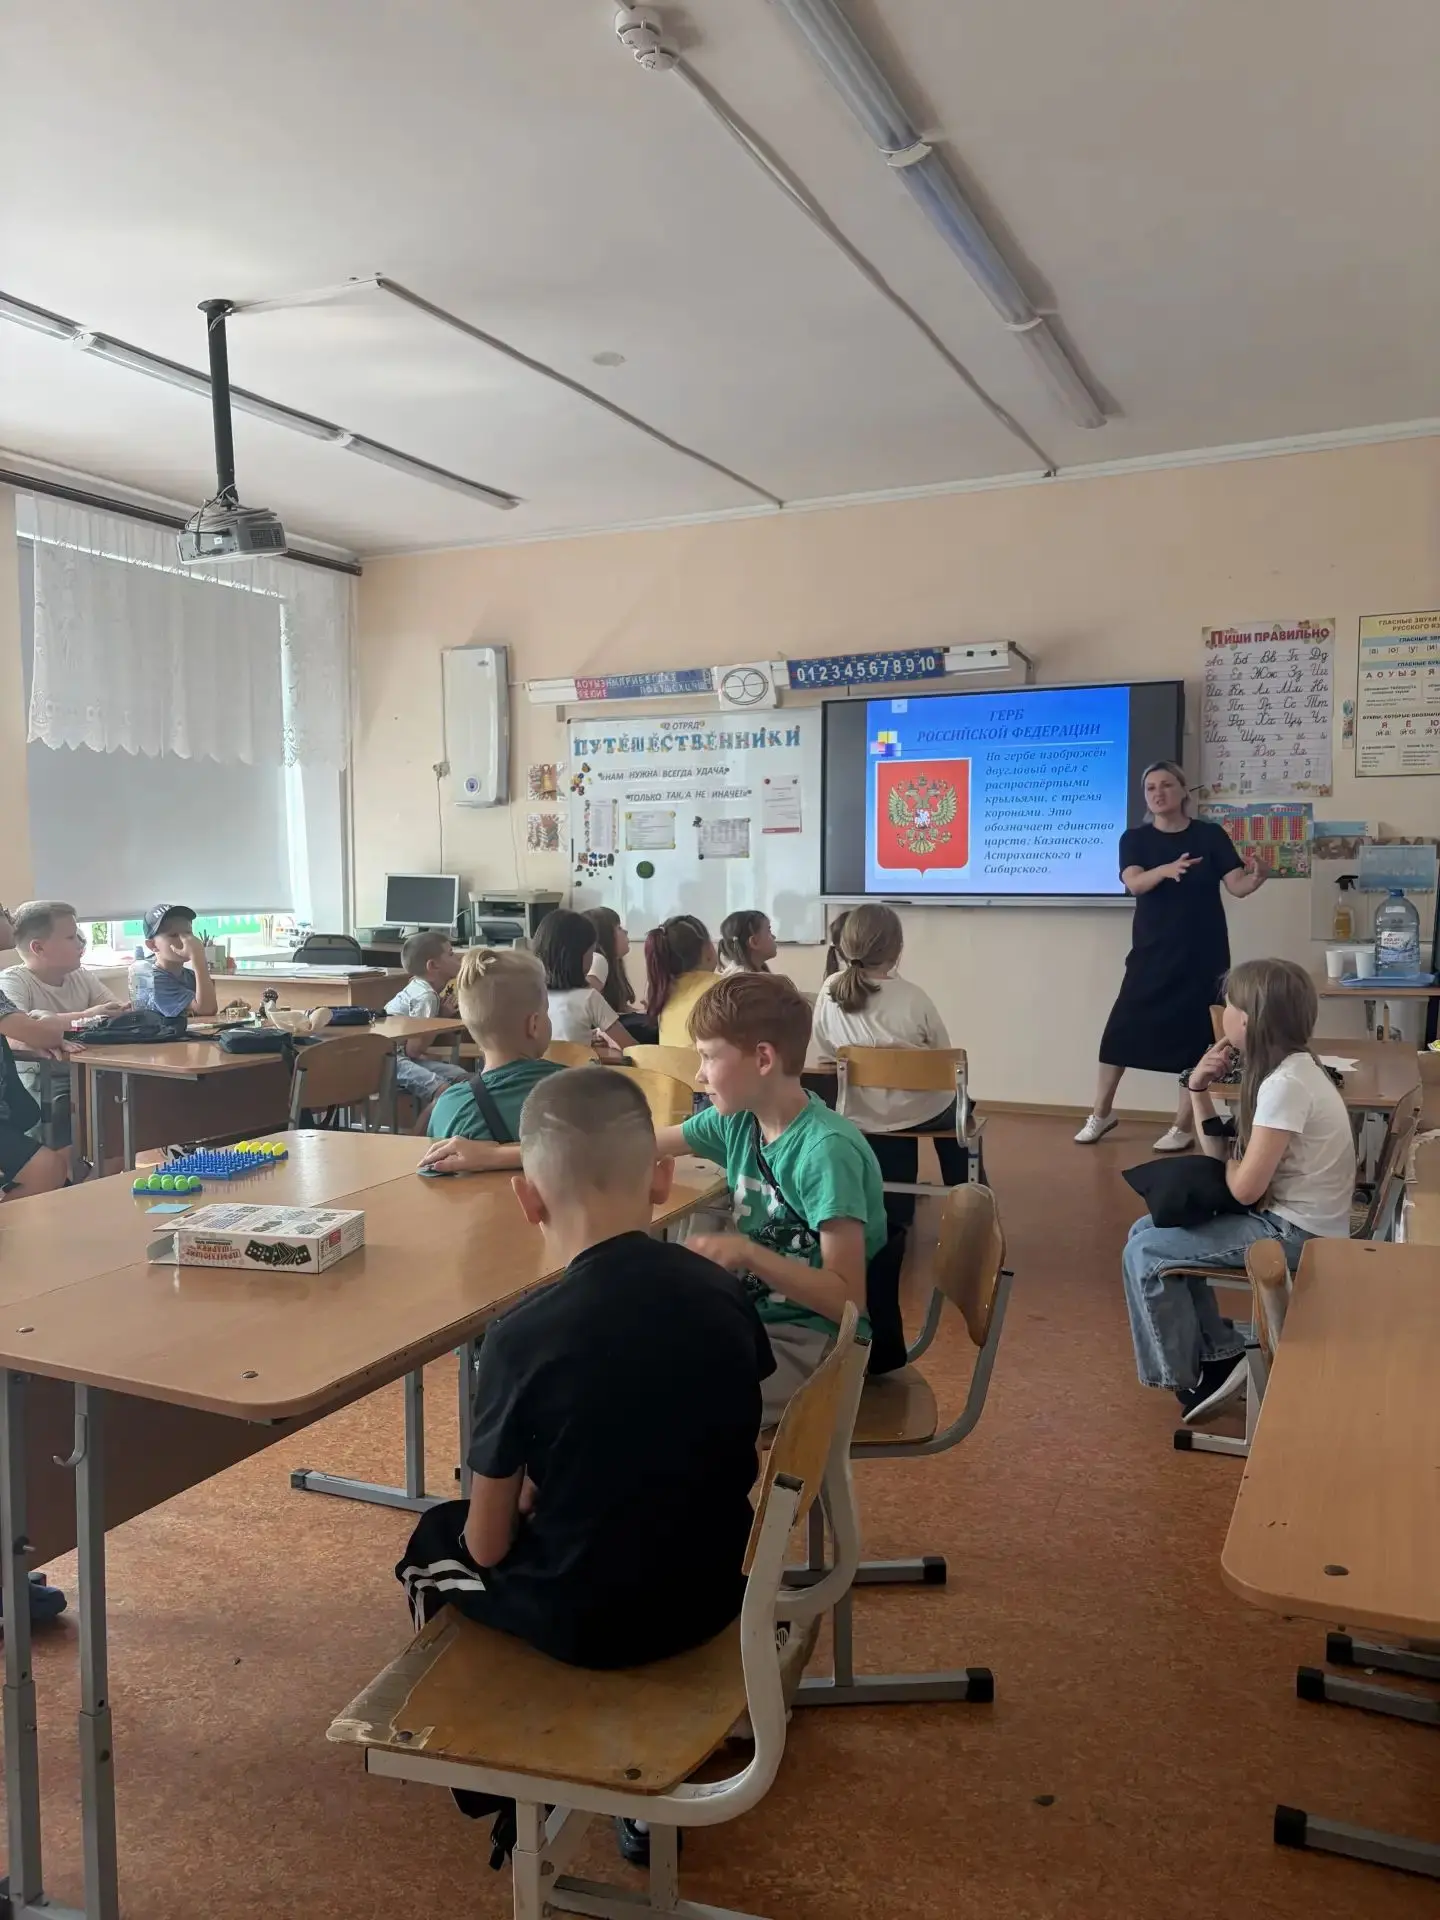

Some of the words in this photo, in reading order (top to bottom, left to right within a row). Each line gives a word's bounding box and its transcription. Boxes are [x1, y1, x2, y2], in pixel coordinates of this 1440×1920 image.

[1392, 624, 1430, 632] РУССКОГО
[1210, 631, 1252, 647] ПИШИ
[1254, 628, 1330, 643] ПРАВИЛЬНО
[1233, 652, 1252, 665] Бб
[1260, 650, 1277, 664] Вв
[1309, 647, 1329, 663] Дд
[797, 668, 806, 682] 0
[808, 667, 815, 681] 1
[819, 666, 829, 680] 2
[832, 665, 840, 679] 3
[845, 663, 853, 677] 4
[857, 662, 866, 676] 5
[869, 661, 878, 675] 6
[880, 660, 888, 674] 7
[893, 659, 902, 673] 8
[906, 658, 914, 672] 9
[919, 656, 935, 671] 10
[1250, 666, 1278, 680] Жж
[1288, 665, 1303, 682] Зз
[1376, 671, 1384, 679] О
[1411, 669, 1417, 677] Э
[1428, 668, 1435, 676] Я
[1276, 680, 1303, 694] Мм
[1310, 679, 1329, 692] Нн
[1284, 696, 1296, 709] Сс
[1304, 694, 1329, 707] Тт
[990, 708, 1025, 722] ГЕРБ
[673, 720, 700, 731] ОТРЯД
[1382, 721, 1388, 729] Я
[917, 725, 1008, 743] РОССИЙСКОЙ
[1012, 723, 1101, 740] ФЕДЕРАЦИИ
[574, 728, 800, 757] ПУТЕШЕСТВЕННИКИ
[986, 752, 1001, 761] На
[1004, 751, 1036, 762] гербе
[1040, 748, 1107, 760] изображён
[629, 770, 658, 779] НУЖНА
[662, 769, 692, 778] ВСЕГДА
[1051, 764, 1077, 776] орёл
[985, 779, 1090, 791] распростёртыми
[696, 790, 706, 798] НЕ
[1051, 795, 1058, 803] с
[1061, 793, 1102, 804] тремя
[985, 809, 1044, 820] коронами.
[1048, 807, 1072, 817] Это
[985, 822, 1053, 832] обозначает
[1057, 821, 1114, 830] единство
[984, 851, 1071, 862] Астраханского
[1075, 851, 1082, 859] и
